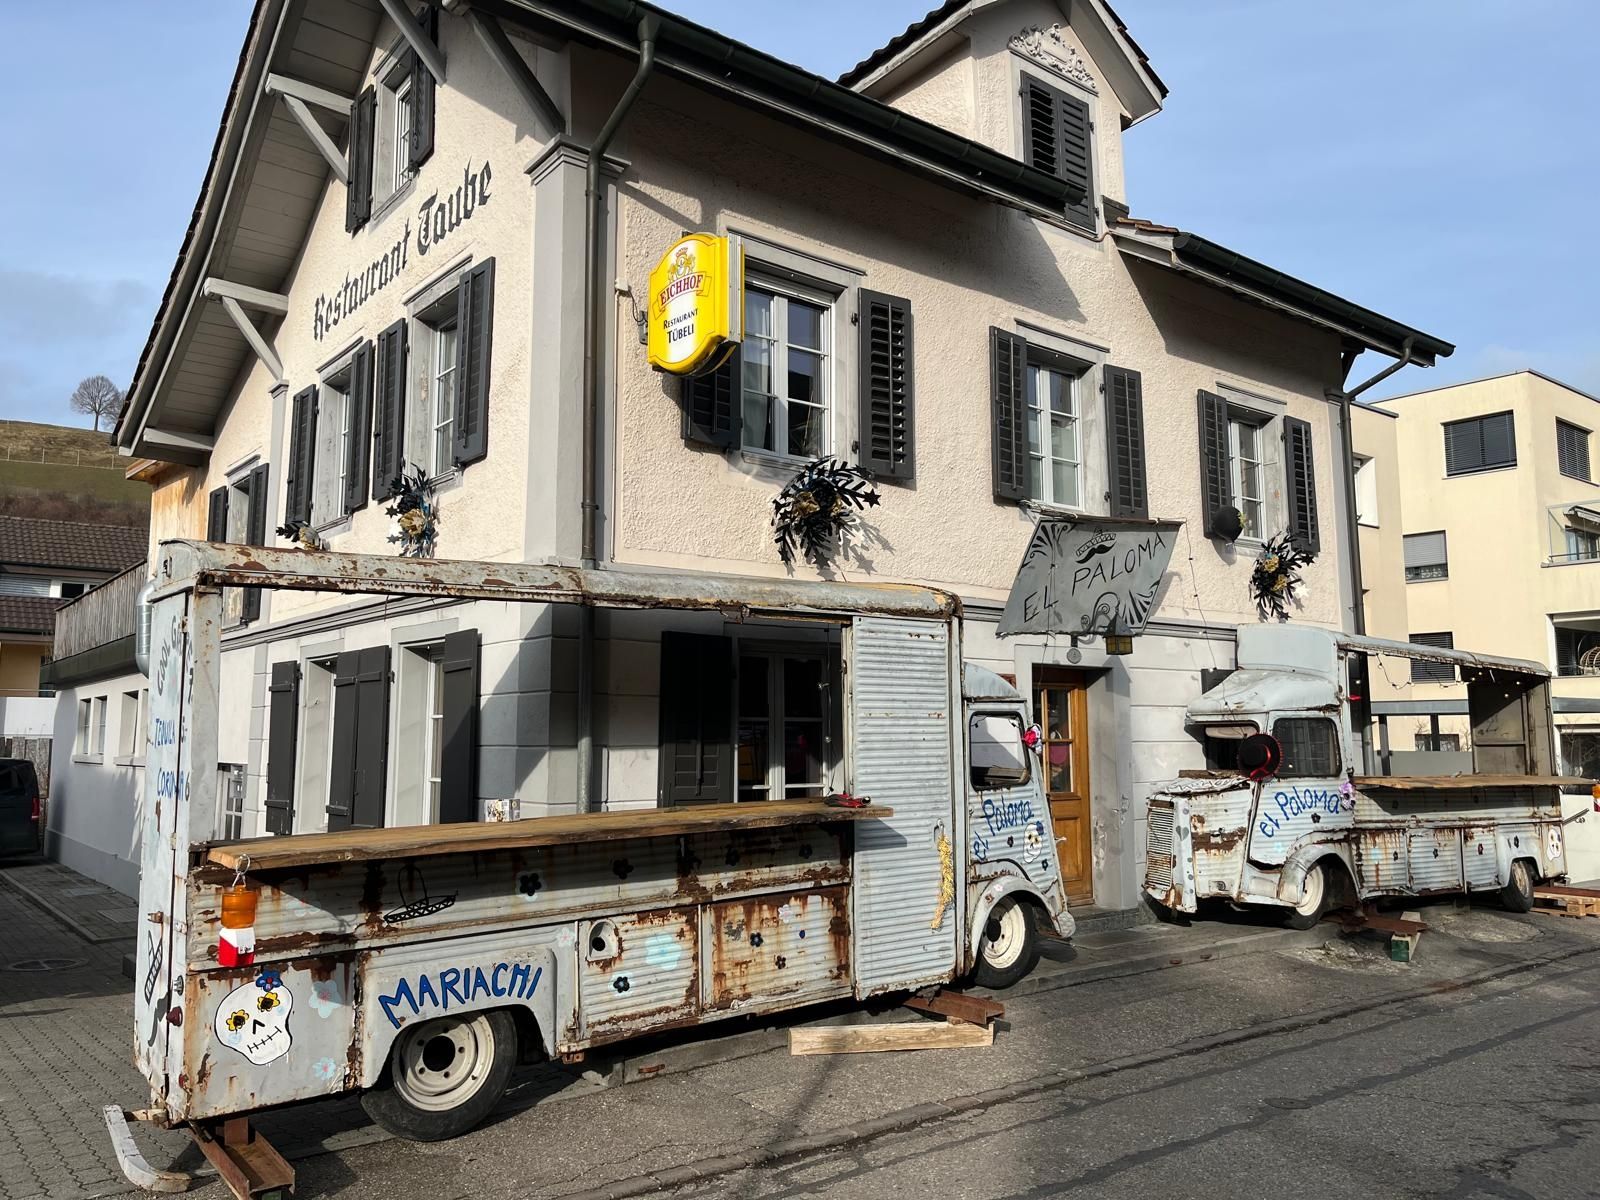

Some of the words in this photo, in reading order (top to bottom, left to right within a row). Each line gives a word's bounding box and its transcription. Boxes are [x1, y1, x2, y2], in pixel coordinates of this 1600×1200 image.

[313, 217, 412, 342] Restaurant
[417, 156, 492, 256] Taube
[660, 274, 704, 306] EICHHOF
[1024, 585, 1059, 623] EL
[1072, 532, 1166, 597] PALOMA
[378, 963, 542, 1030] MARIACHI
